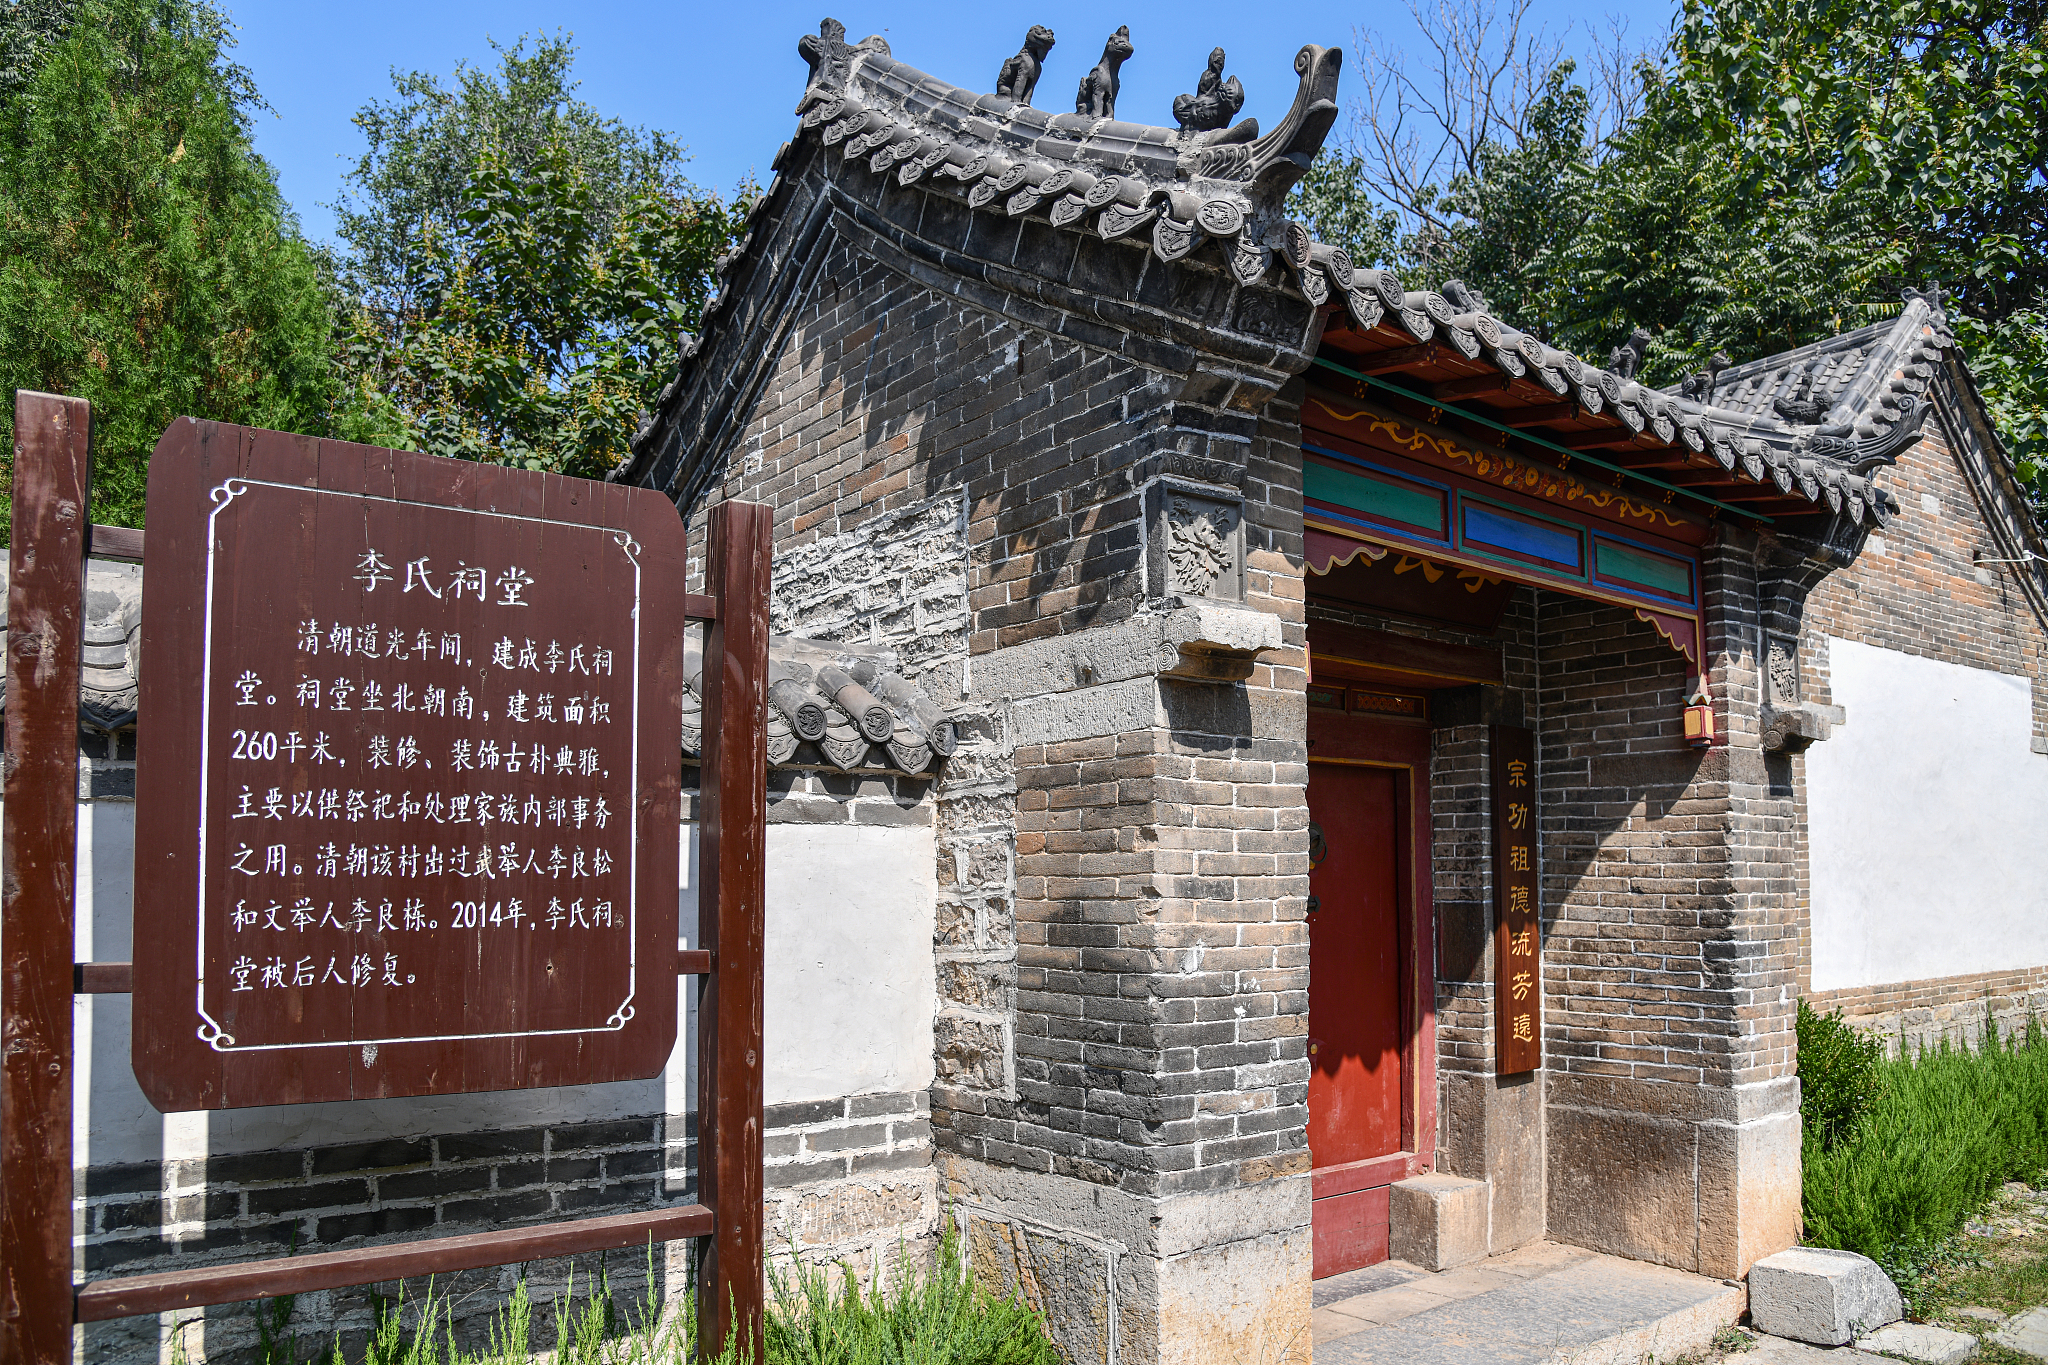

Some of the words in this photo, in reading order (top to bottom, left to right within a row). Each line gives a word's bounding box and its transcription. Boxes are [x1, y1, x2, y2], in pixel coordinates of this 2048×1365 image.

[353, 548, 534, 607] 李氏祠堂
[298, 618, 613, 676] 清朝道光年间，建成李氏祠
[235, 669, 612, 725] 堂。祠堂坐北朝南，建筑面积
[232, 785, 613, 830] 主要以供祭祀和处理家族内部事务
[231, 841, 614, 880] 之用。清朝该村出过武举人李良松
[231, 896, 614, 933] 和文举人李良栋。2014年，李氏祠
[1506, 758, 1534, 1042] 宗功祖德流芳遠
[231, 952, 416, 992] 堂被后人修复。
